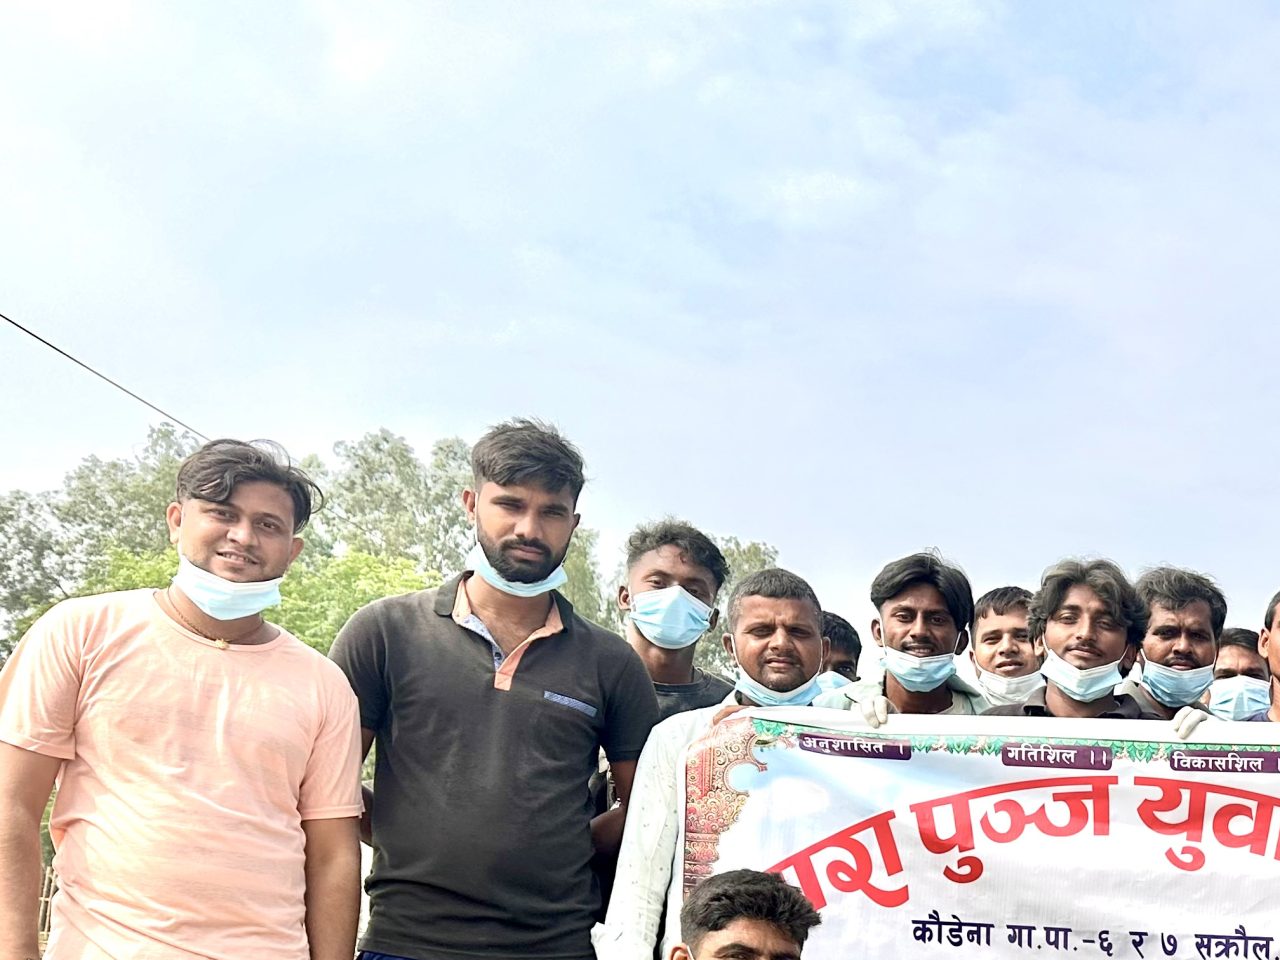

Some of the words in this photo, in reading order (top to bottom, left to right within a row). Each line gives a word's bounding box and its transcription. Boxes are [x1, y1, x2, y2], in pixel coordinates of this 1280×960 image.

[802, 737, 886, 754] अनुशासित
[1006, 744, 1078, 764] गतिशिल
[1172, 752, 1265, 772] विकासशिल
[911, 910, 995, 947] कौडेना
[1006, 924, 1113, 957] गा.पा.-६
[1129, 930, 1149, 959] र
[1161, 932, 1178, 957] ७
